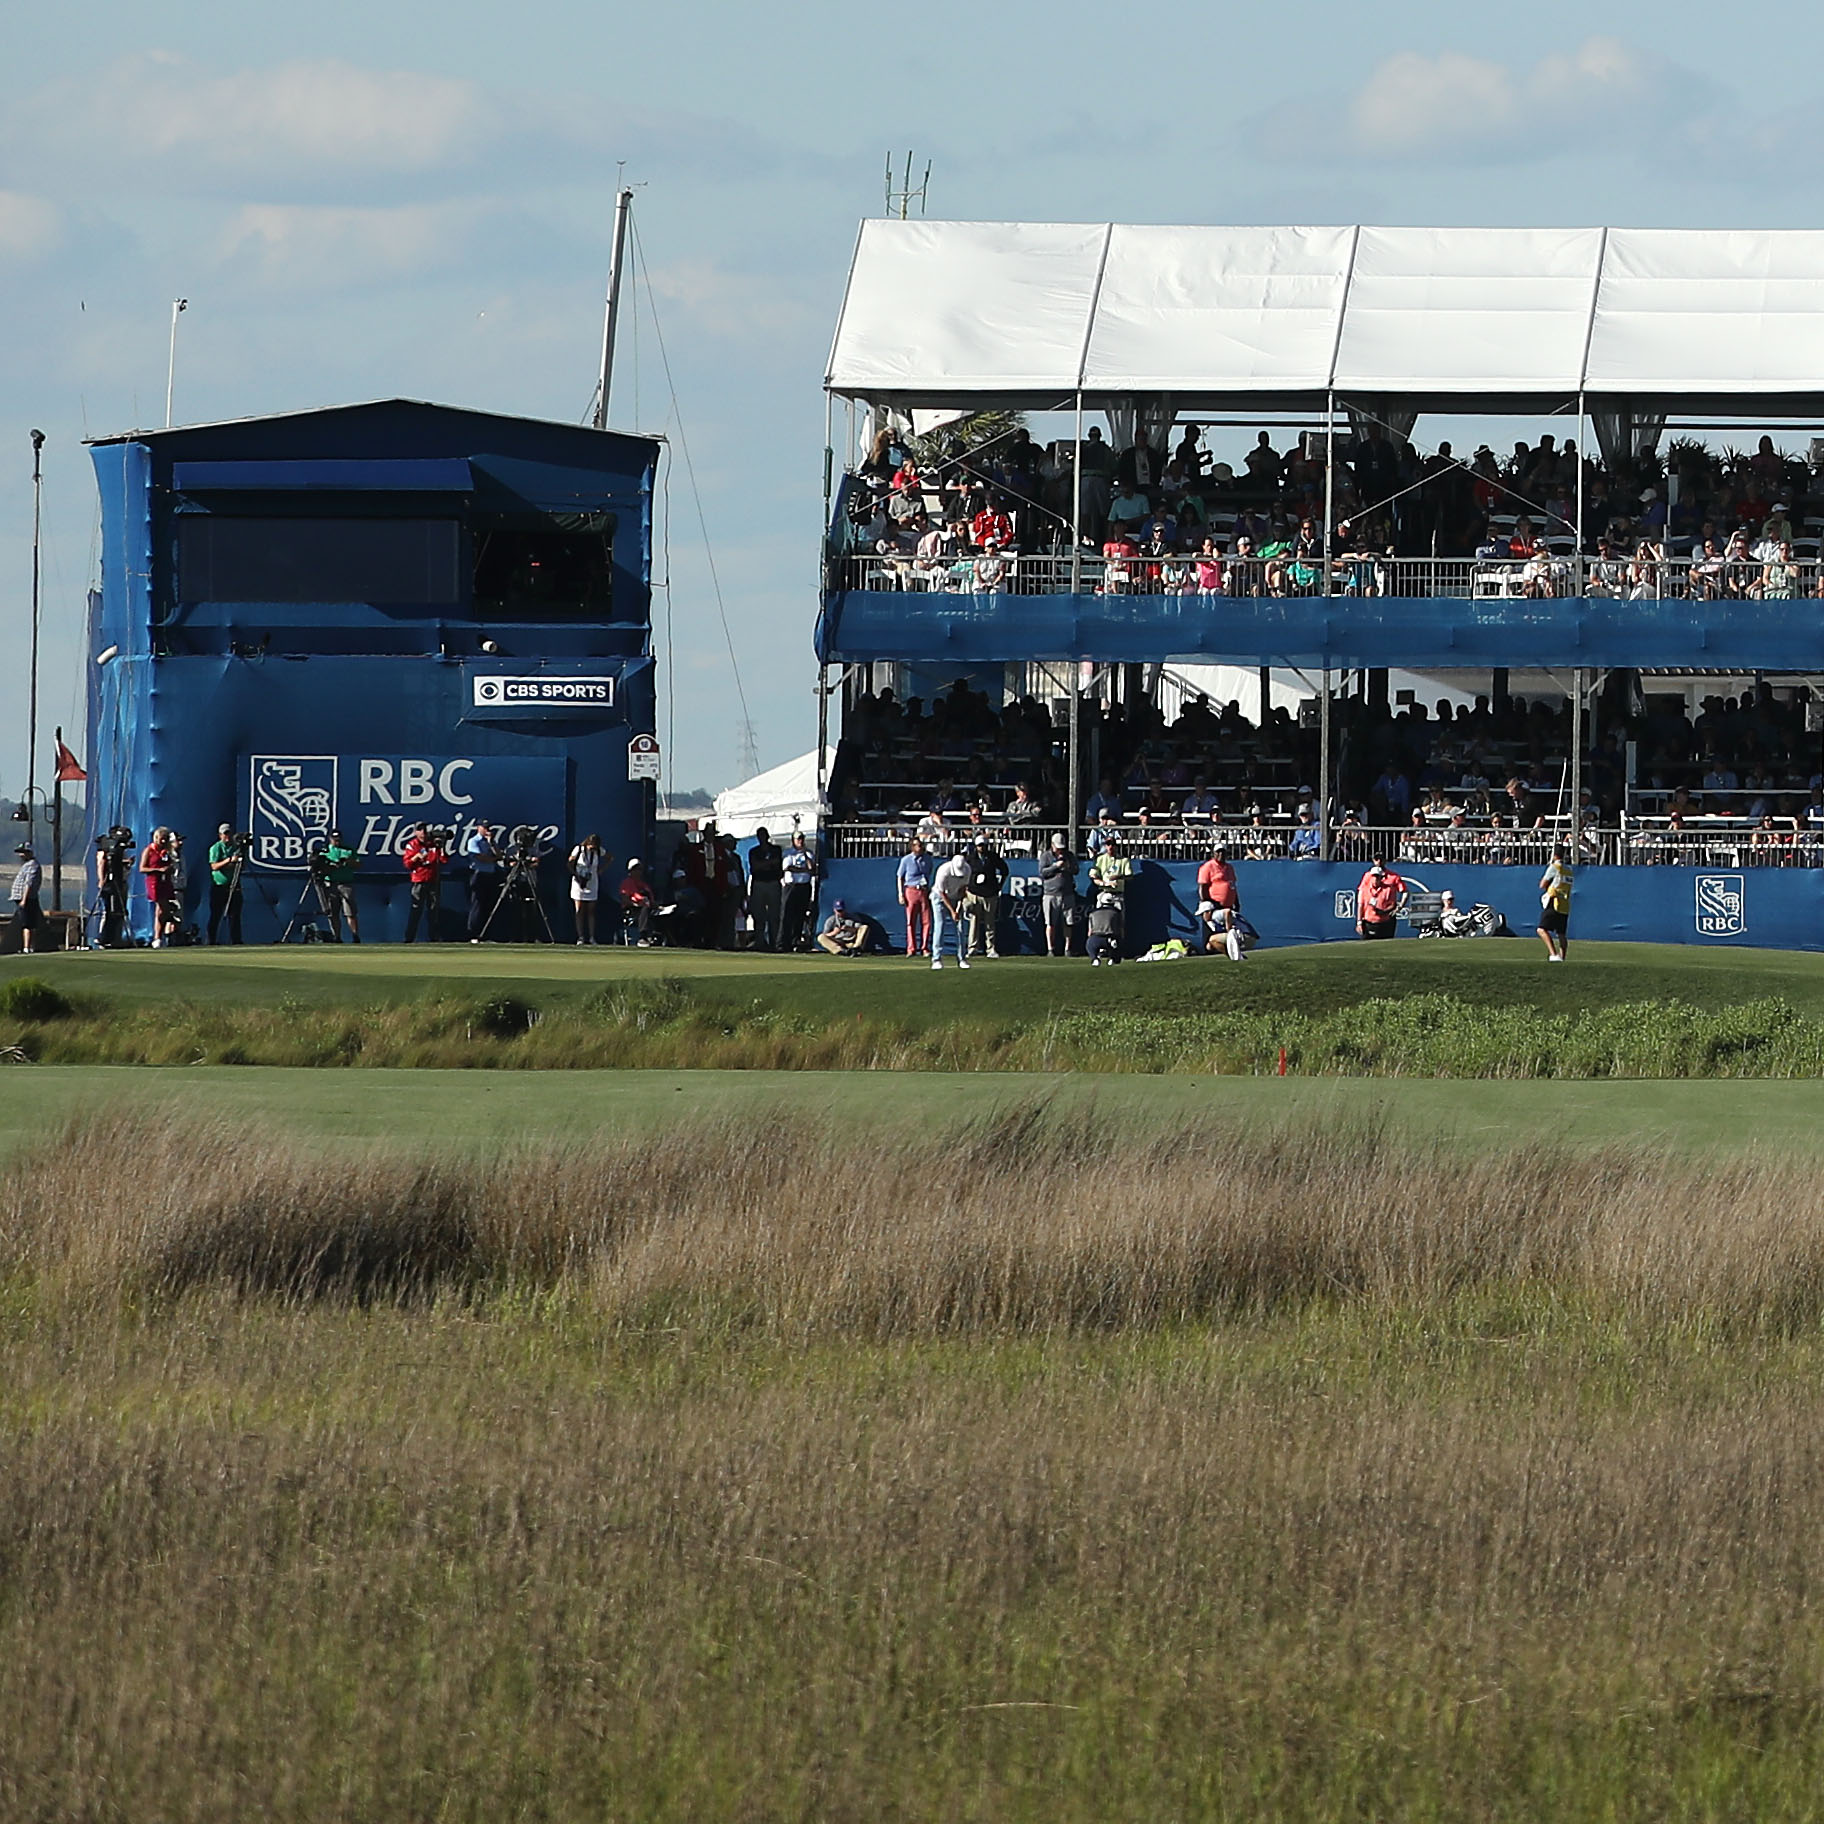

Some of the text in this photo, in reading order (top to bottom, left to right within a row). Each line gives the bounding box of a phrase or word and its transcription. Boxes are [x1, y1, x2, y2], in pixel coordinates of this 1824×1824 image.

[506, 683, 607, 699] CBS SPORTS
[359, 759, 475, 805] RBC
[259, 836, 327, 860] RBC
[356, 812, 560, 867] Heite
[1010, 876, 1043, 897] RB
[1702, 917, 1740, 931] RBC
